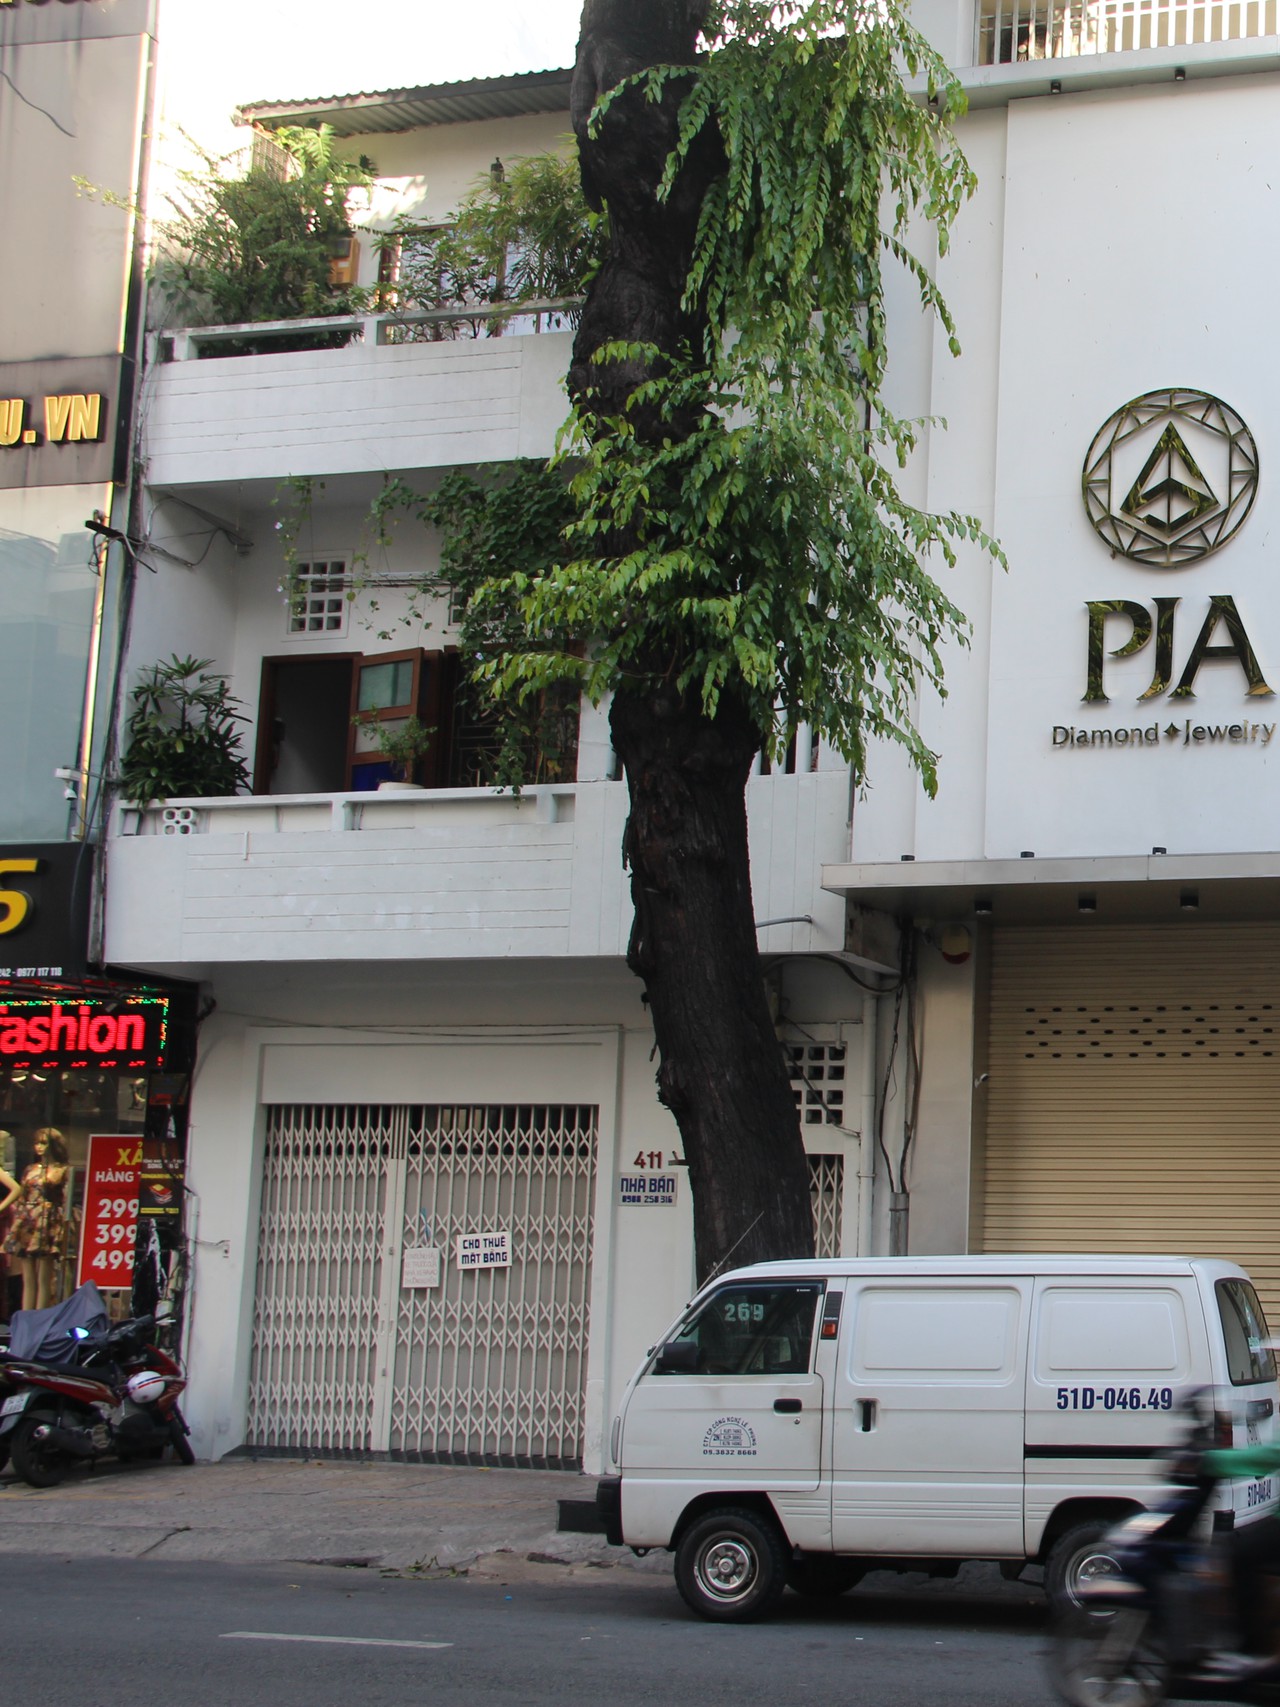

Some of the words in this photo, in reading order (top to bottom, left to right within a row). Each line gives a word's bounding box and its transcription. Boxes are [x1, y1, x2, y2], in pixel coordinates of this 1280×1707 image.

[1080, 595, 1277, 702] PJA
[1052, 722, 1159, 746] Diamond
[1182, 719, 1277, 746] Jewelry
[633, 1151, 662, 1169] 411
[621, 1175, 646, 1192] NHÀ
[649, 1175, 675, 1193] BÁN
[463, 1239, 480, 1249] CHO
[483, 1235, 506, 1248] THUÊ
[724, 1303, 764, 1321] 269
[1057, 1387, 1173, 1410] 51D-046.49
